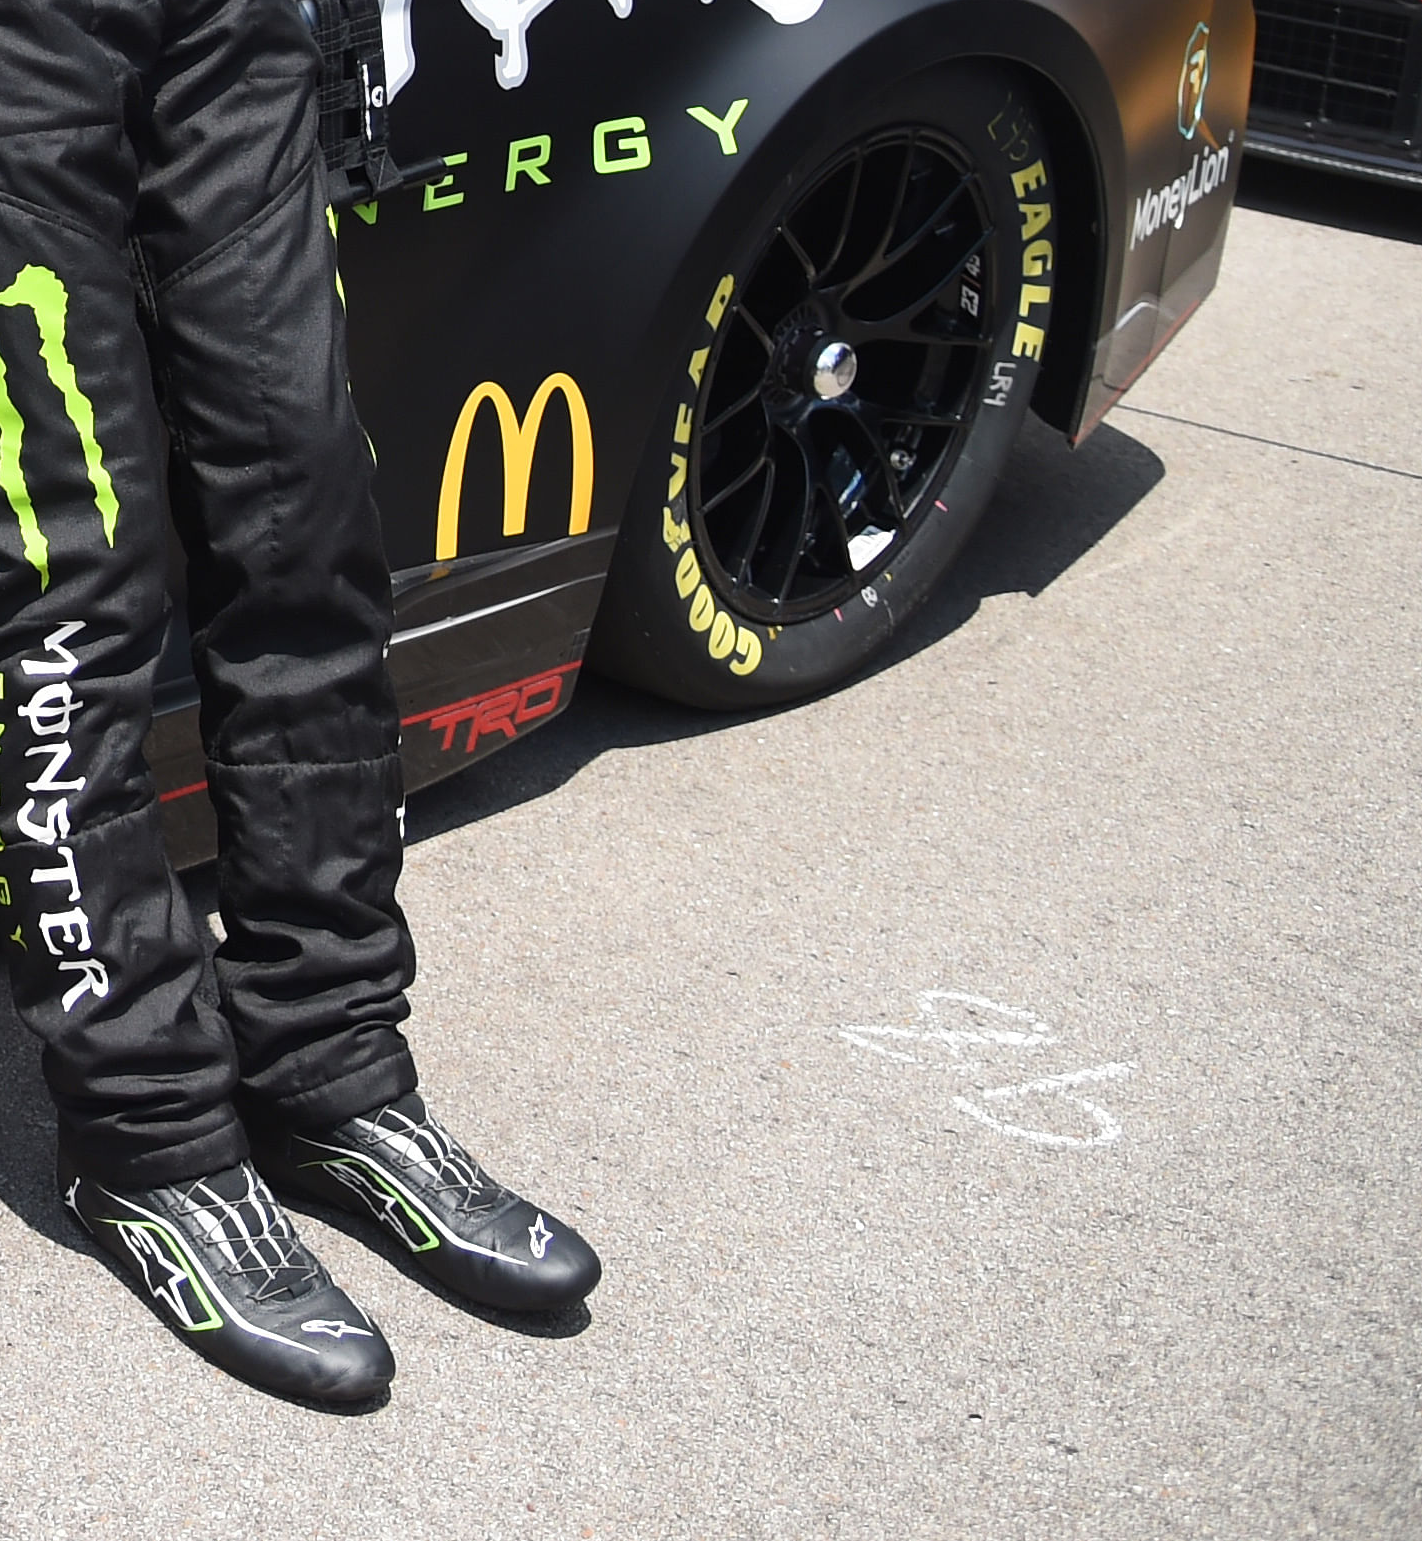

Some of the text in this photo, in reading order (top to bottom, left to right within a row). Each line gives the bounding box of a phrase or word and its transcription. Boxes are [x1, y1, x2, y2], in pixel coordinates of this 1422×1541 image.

[1010, 159, 1054, 362] EAGLE
[1129, 144, 1231, 251] MoneyLion
[662, 273, 763, 676] GOODYEAR
[428, 676, 563, 754] TRD
